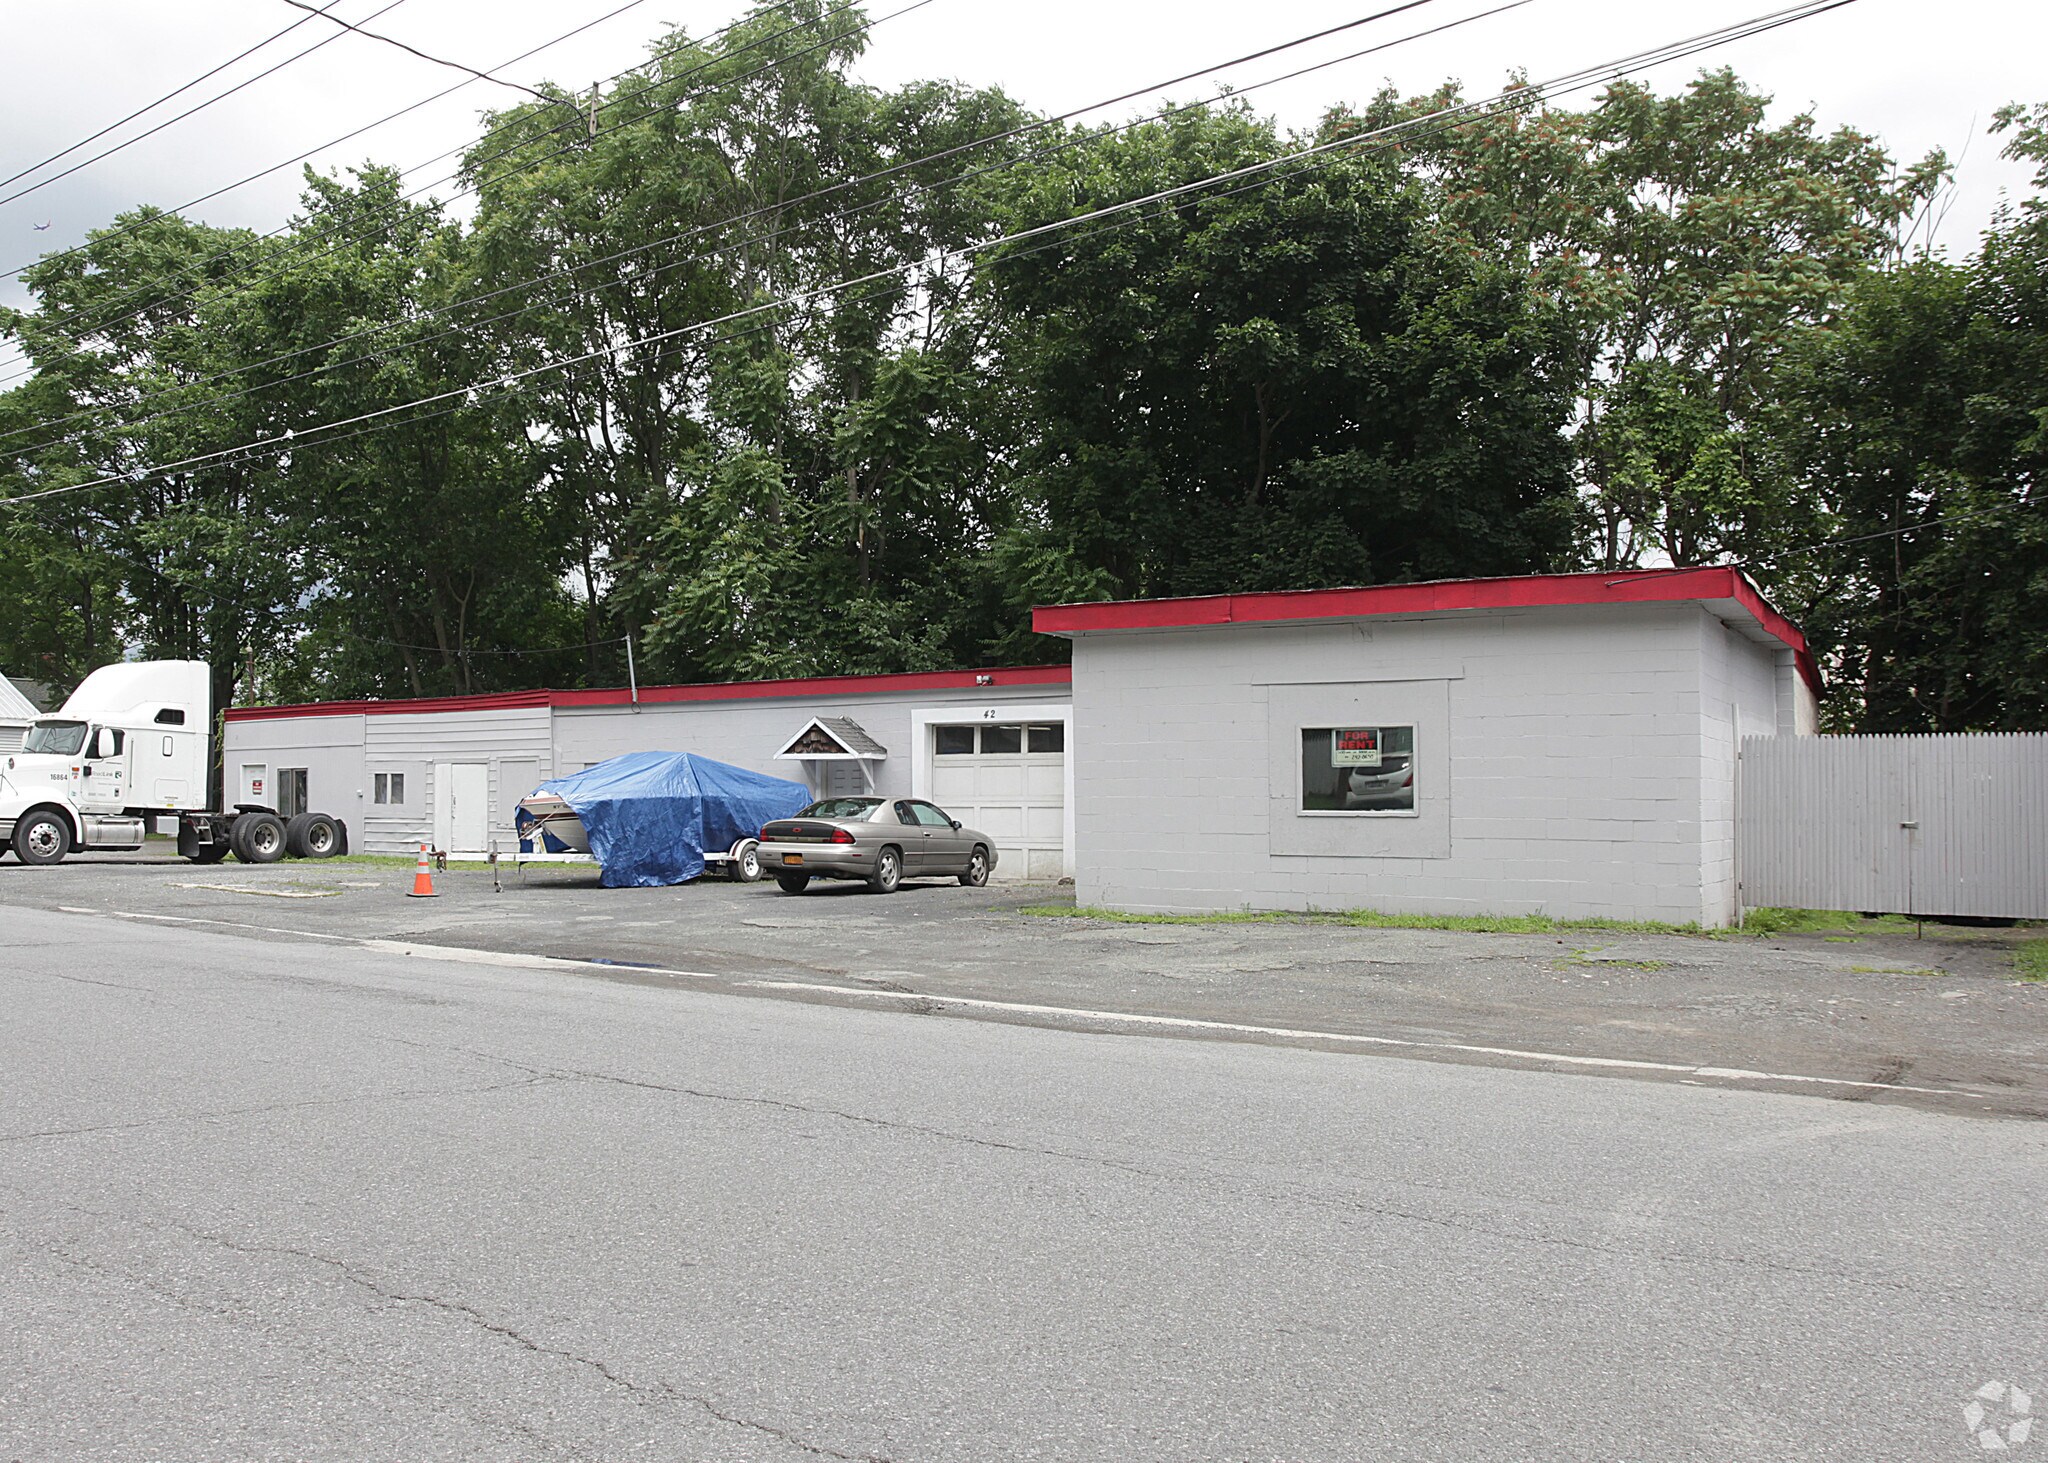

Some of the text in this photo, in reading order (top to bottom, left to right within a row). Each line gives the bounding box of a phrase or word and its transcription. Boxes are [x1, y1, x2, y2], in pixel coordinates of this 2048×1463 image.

[984, 709, 995, 718] 42
[1345, 731, 1368, 740] FOR
[1338, 740, 1375, 749] RENT
